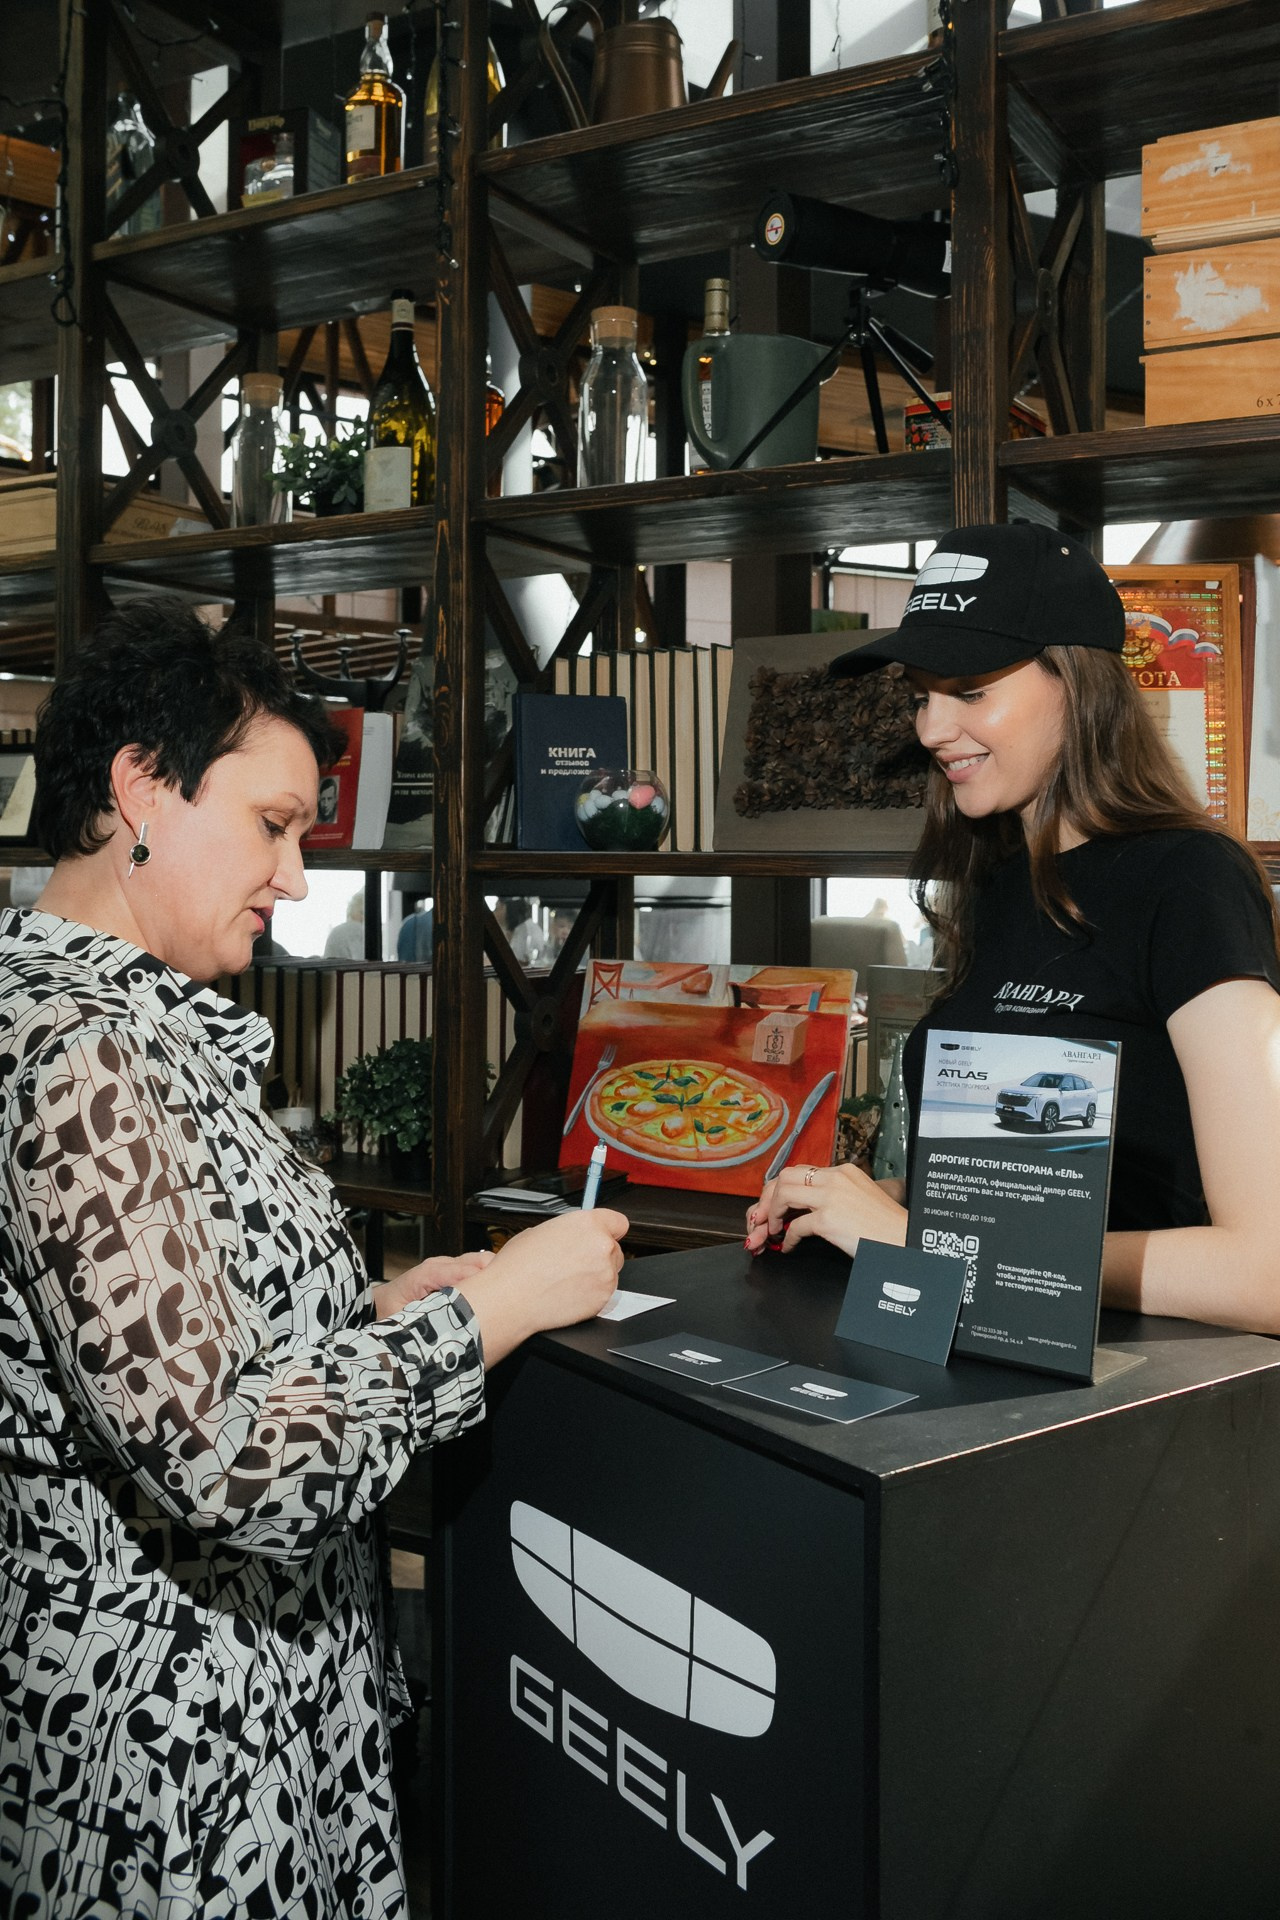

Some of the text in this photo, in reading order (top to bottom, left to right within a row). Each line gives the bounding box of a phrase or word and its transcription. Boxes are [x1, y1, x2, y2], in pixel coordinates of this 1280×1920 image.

[548, 747, 597, 758] КНИГА
[937, 1068, 989, 1081] ATLAS
[928, 1153, 1084, 1179] ДОРОГИЕ ГОСТИ РЕСТОРАНА «ЕЛЬ»
[926, 1181, 939, 1190] рад
[940, 1183, 980, 1194] пригласить
[981, 1188, 993, 1196] вас
[1005, 1191, 1045, 1203] тест-драйв
[927, 1171, 989, 1186] АВАНГАРД-ЛАХТА,
[990, 1179, 1042, 1193] официальный
[1042, 1186, 1066, 1197] дилер
[925, 1189, 968, 1202] GEELY ATLAS
[931, 1208, 949, 1217] ИЮНЯ
[955, 1212, 970, 1220] 11:00
[969, 1214, 980, 1222] ДО
[980, 1216, 996, 1224] 19:00
[997, 1263, 1042, 1277] Отсканируйте
[996, 1272, 1082, 1291] чтобы зарегистрироваться
[1004, 1281, 1034, 1292] тестовую
[1034, 1286, 1061, 1298] поездку
[877, 1299, 917, 1317] GEELY
[668, 1352, 709, 1366] GEELY
[789, 1386, 836, 1400] GEELY
[510, 1653, 776, 1891] GEELY
